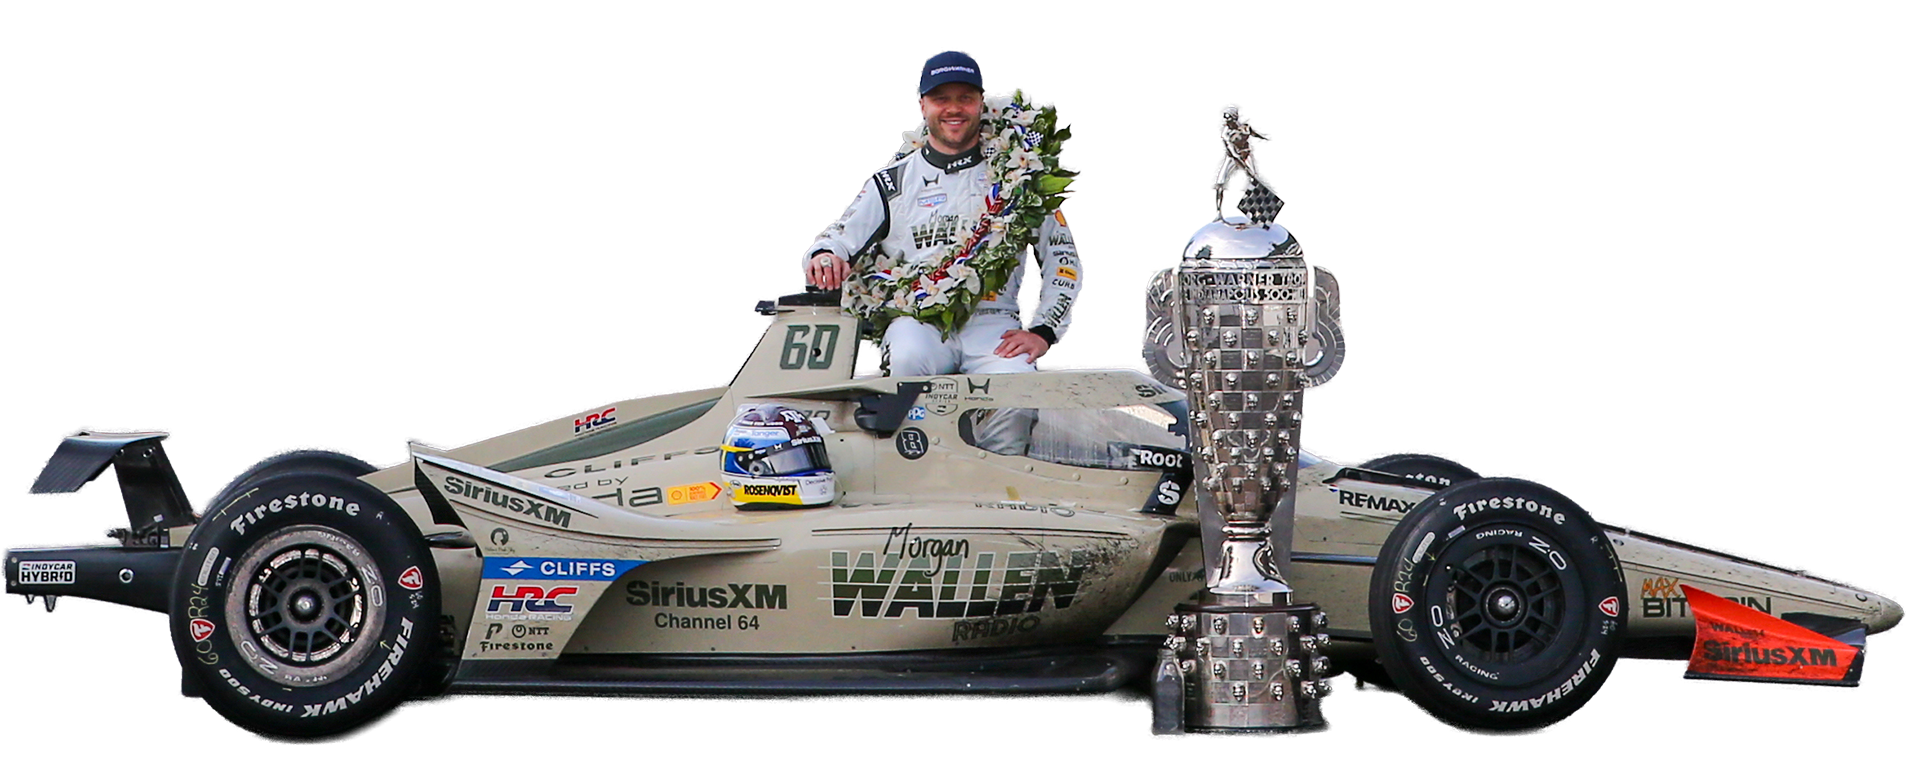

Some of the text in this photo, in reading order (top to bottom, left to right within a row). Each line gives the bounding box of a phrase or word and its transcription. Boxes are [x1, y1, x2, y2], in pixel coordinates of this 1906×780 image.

[779, 324, 840, 370] 60
[574, 407, 616, 433] HRC
[908, 407, 925, 420] PPG
[1140, 449, 1183, 468] Root
[597, 476, 628, 486] by
[743, 484, 797, 496] ROSENQVIST
[229, 492, 361, 535] Firestone
[444, 476, 572, 528] SiriusXM
[1453, 496, 1566, 526] Firestone
[883, 523, 969, 577] Morgan
[21, 571, 73, 582] HYBRID
[540, 561, 616, 577] CLIFFS
[626, 580, 788, 610] SiriusXM
[830, 549, 1087, 618] WALLEN
[486, 585, 579, 613] HRC
[528, 627, 550, 635] NTT
[655, 613, 760, 631] Channel 64
[952, 615, 1041, 642] RADIO
[479, 641, 554, 652] Firestone
[1702, 639, 1837, 667] SiriusXM
[301, 616, 415, 719] FIREHAWK
[1488, 648, 1601, 712] FIREHAWK
